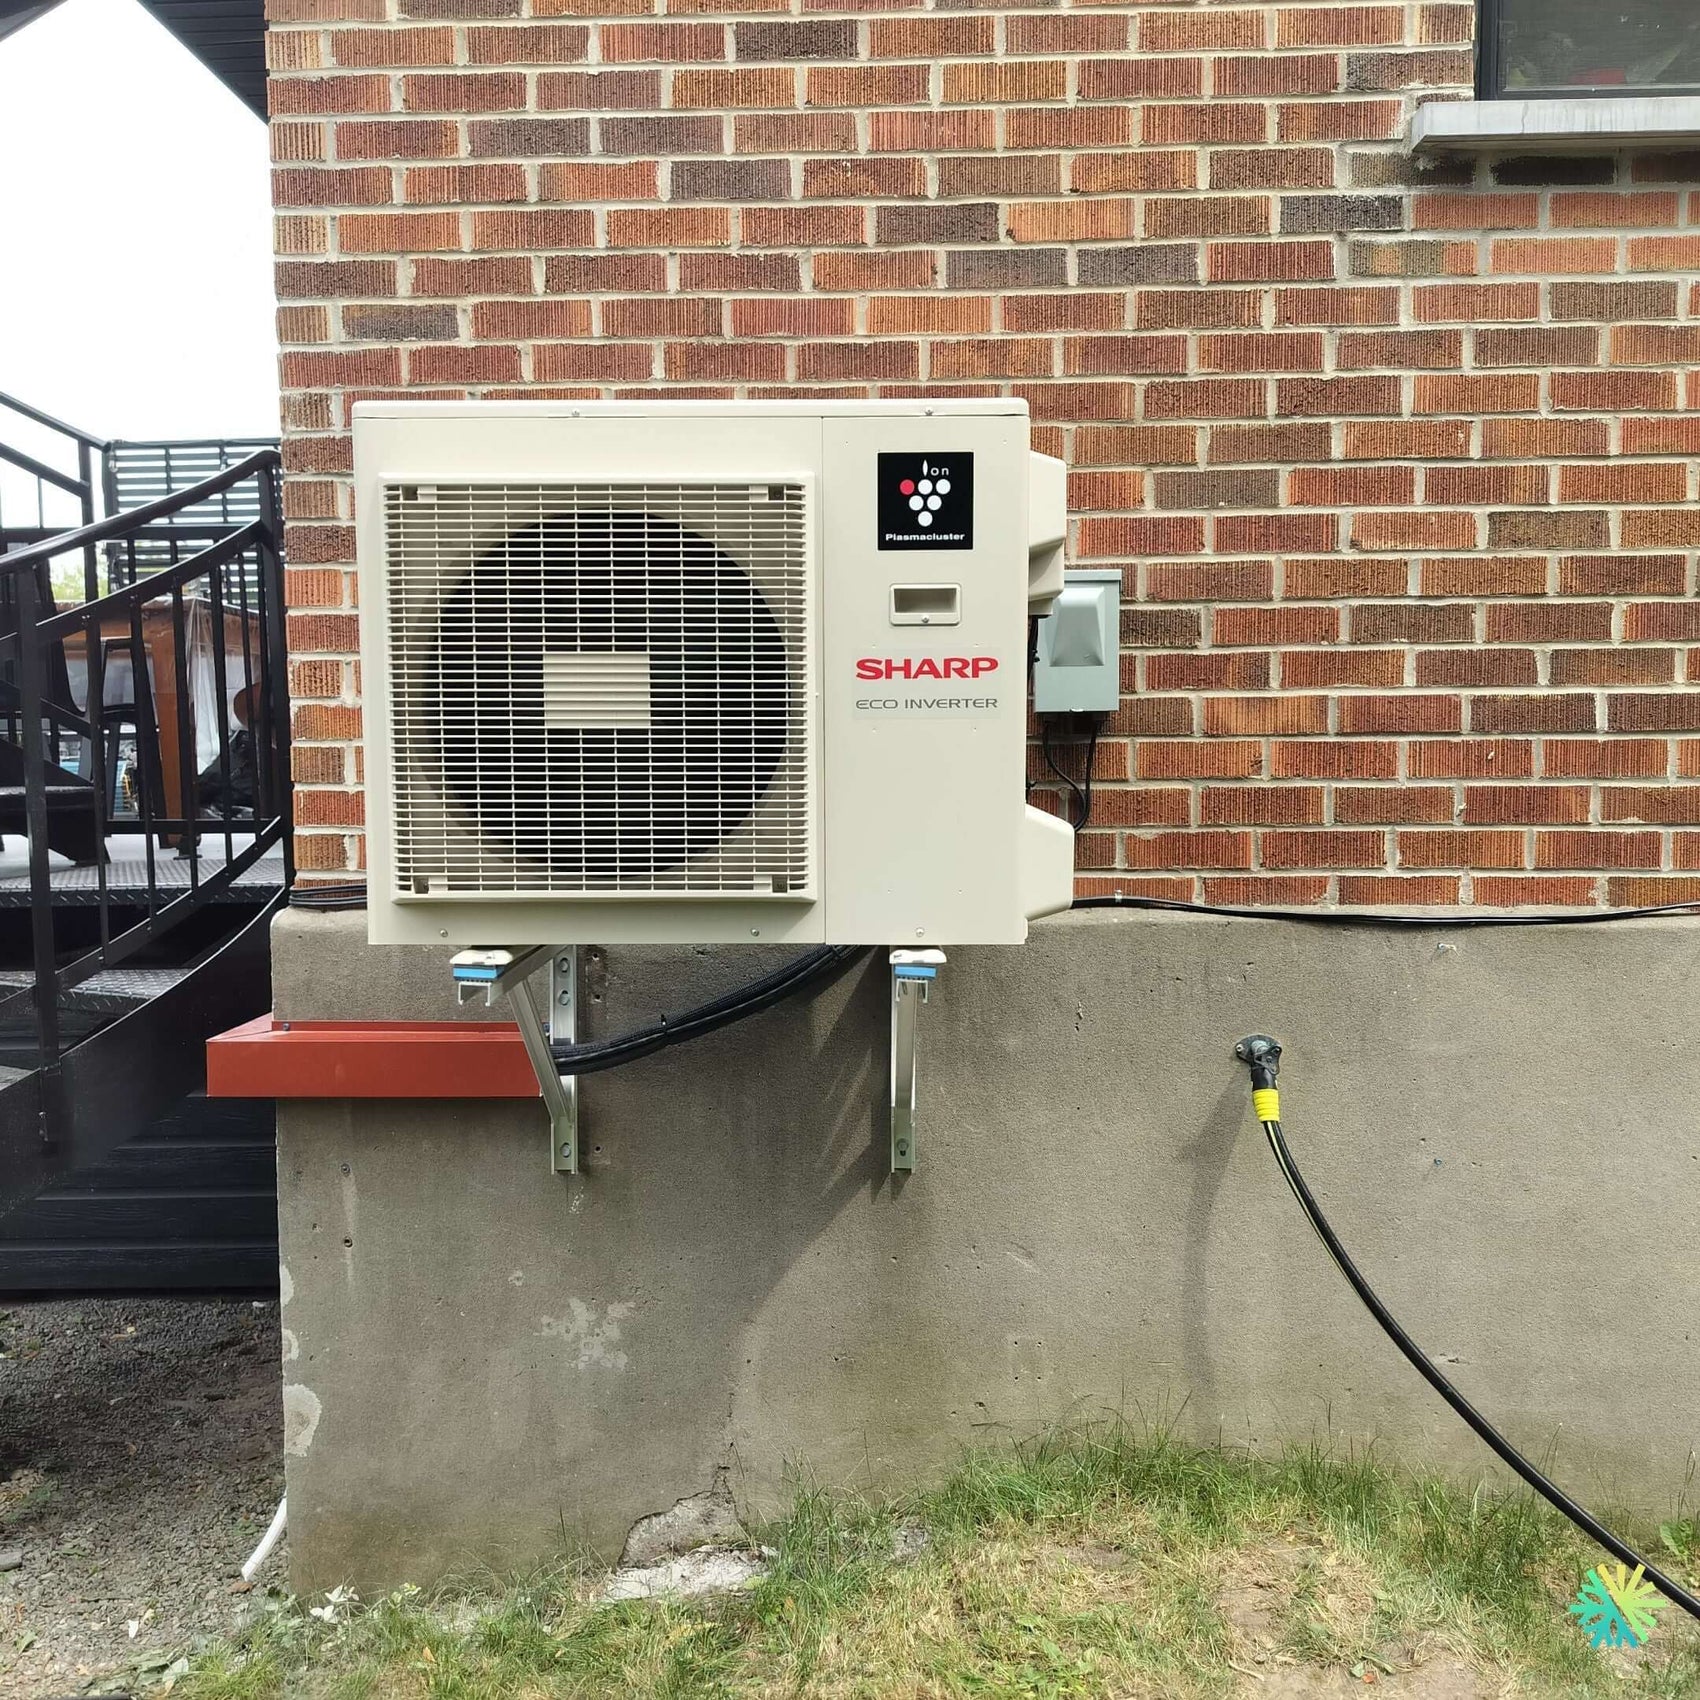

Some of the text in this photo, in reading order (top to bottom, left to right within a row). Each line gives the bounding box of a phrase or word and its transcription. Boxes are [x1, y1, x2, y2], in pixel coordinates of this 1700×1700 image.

[885, 532, 966, 542] Plasmacluster
[856, 656, 999, 681] SHARP
[855, 698, 998, 710] ECO INVERTER
